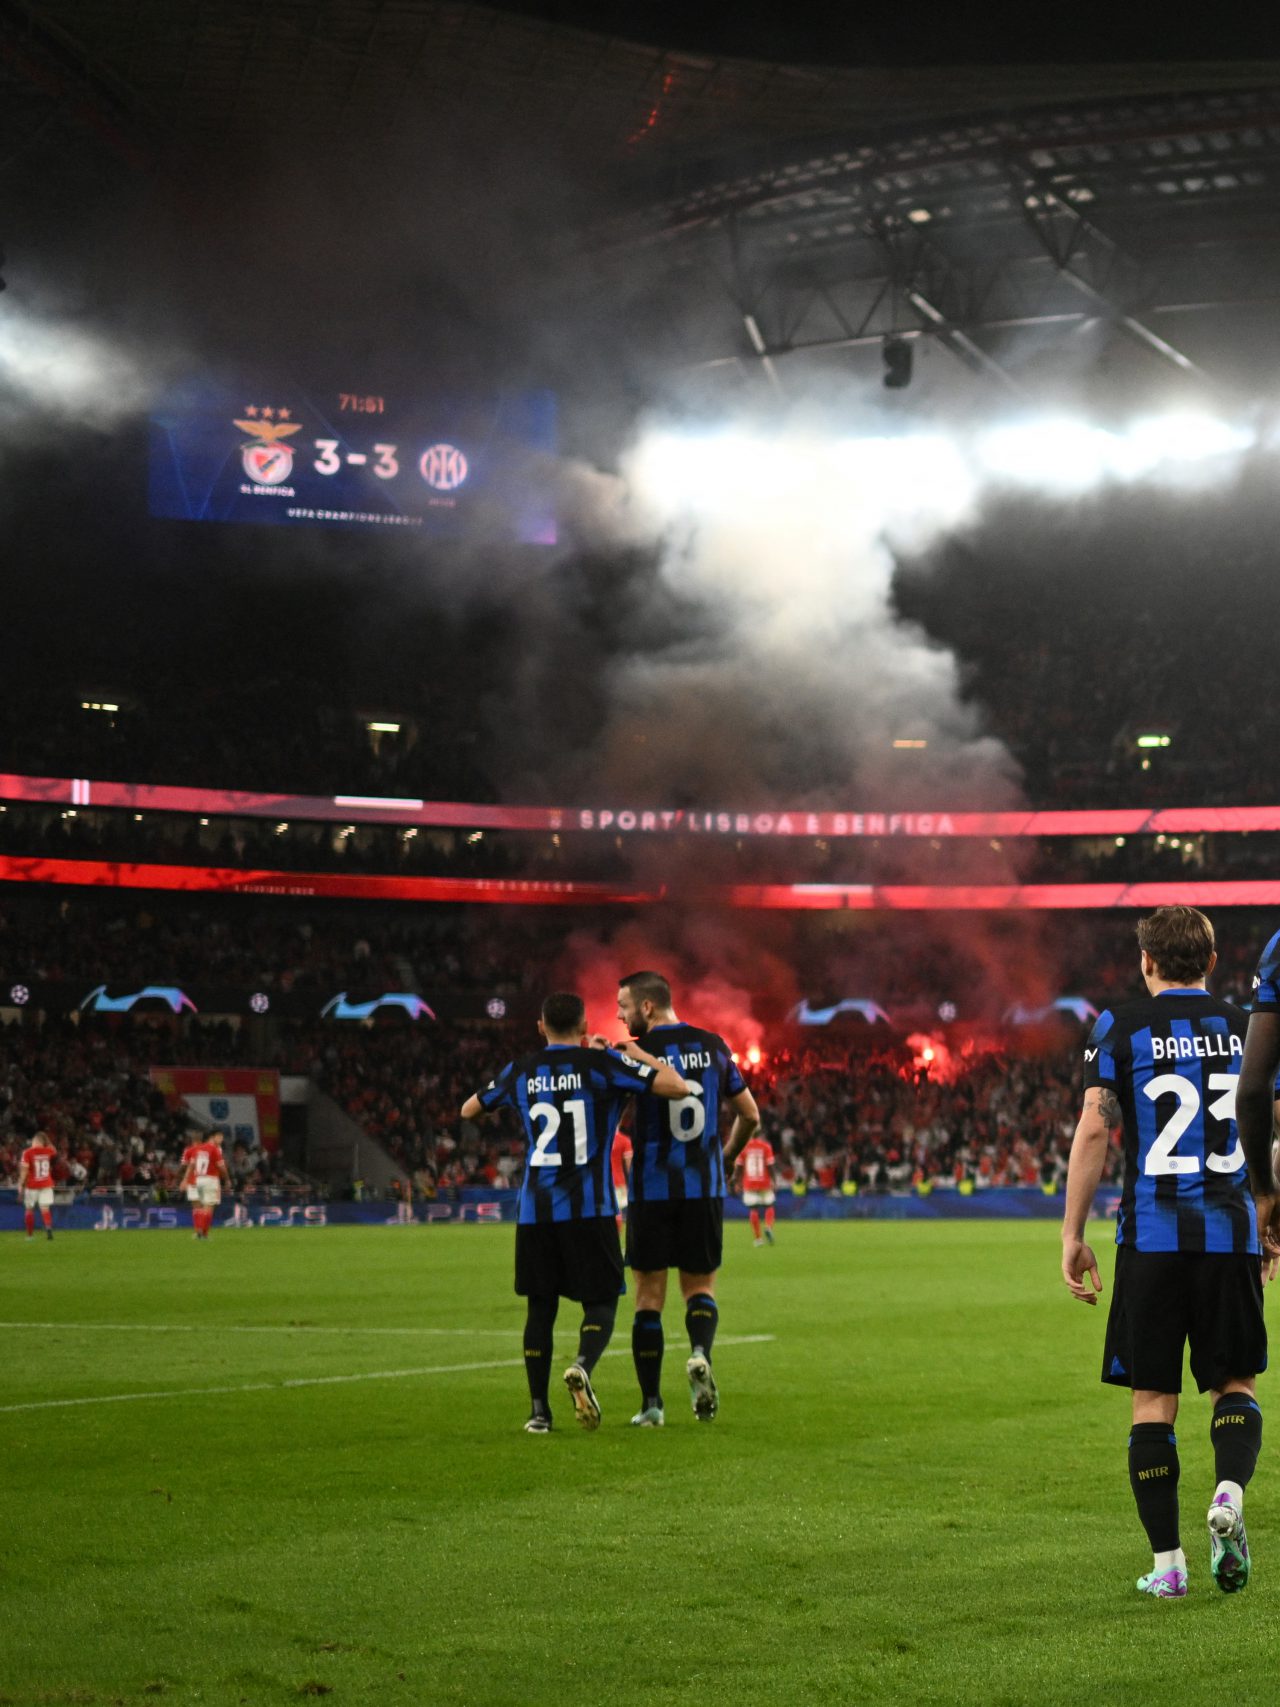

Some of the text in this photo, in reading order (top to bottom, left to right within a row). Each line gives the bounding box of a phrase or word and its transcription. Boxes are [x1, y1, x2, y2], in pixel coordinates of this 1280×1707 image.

[580, 810, 955, 836] SPORT LISBOA E BENFICA
[1151, 1034, 1243, 1060] BARELLA
[681, 1051, 711, 1070] VRIJ
[527, 1073, 581, 1094] ASLLANI
[669, 1080, 705, 1142] 6
[529, 1100, 588, 1167] 21
[1143, 1073, 1246, 1176] 23
[34, 1159, 50, 1178] 19
[123, 1207, 178, 1228] PS5
[260, 1205, 327, 1227] PS5
[428, 1202, 500, 1224] PS5
[1214, 1415, 1245, 1428] INTER
[1138, 1466, 1169, 1480] INTER
